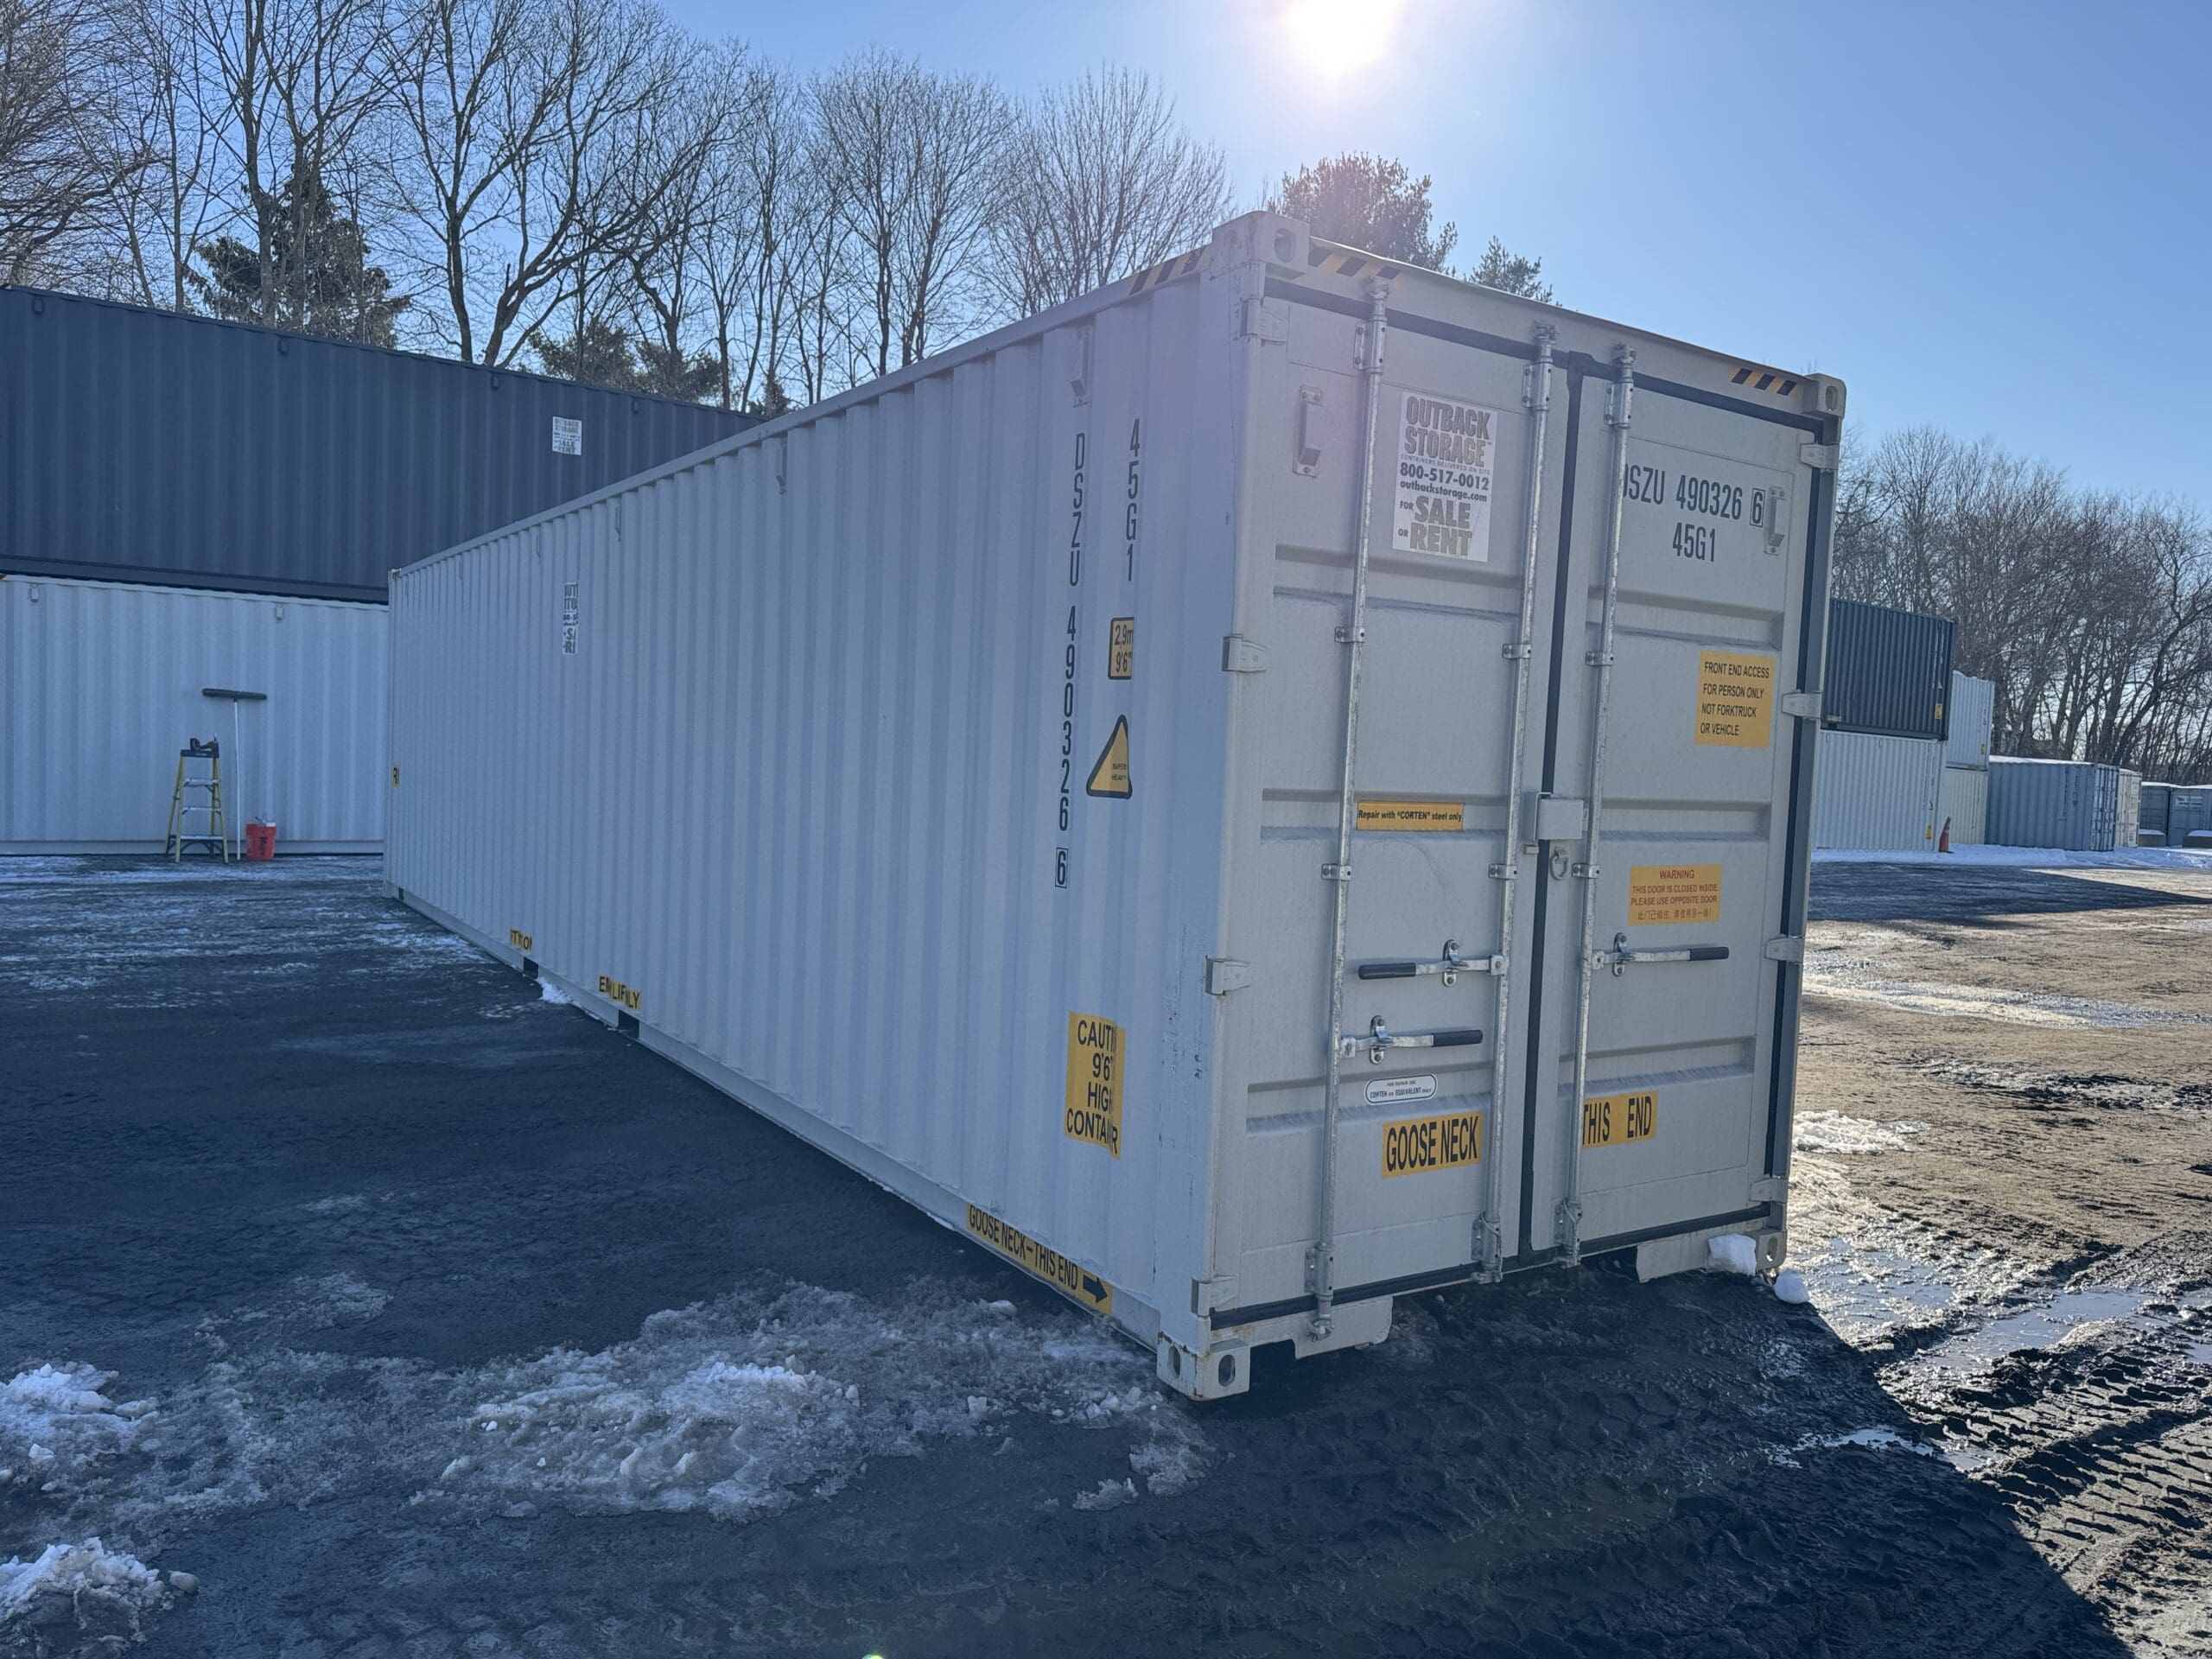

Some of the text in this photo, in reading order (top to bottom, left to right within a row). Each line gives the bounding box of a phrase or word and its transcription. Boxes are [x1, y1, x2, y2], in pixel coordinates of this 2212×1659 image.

[1406, 396, 1491, 440] OUTBACK
[1404, 426, 1485, 467] STORAGE
[1400, 462, 1489, 491] 800-517-0012
[1401, 454, 1435, 466] CONTAINERS
[1437, 461, 1467, 471] DELIVERED
[1126, 418, 1140, 582] 45G1
[1400, 480, 1487, 503] outbackstorage.com
[1676, 474, 1742, 519] 490326
[1751, 491, 1764, 524] 6
[1400, 495, 1471, 530] FOR SALE
[1398, 522, 1472, 556] OR RENT
[1673, 522, 1715, 562] 45G1
[1057, 433, 1085, 886] DSZU 490326 6
[1704, 661, 1770, 678] FRONT END ACCESS
[1703, 683, 1764, 699] FOR PERSON ONLY
[1701, 703, 1757, 718] NOT FORKTRUCK
[1700, 722, 1739, 736] OR VEHICLE
[1358, 810, 1380, 821] Repair
[1449, 813, 1462, 822] only
[1632, 886, 1647, 894] THIS
[1648, 885, 1666, 893] DOOR
[1674, 884, 1698, 893] CLOSED
[1659, 869, 1695, 880] WARNING
[1630, 898, 1655, 906] PLEASE
[1670, 896, 1700, 905] OPPOSITE
[1077, 1020, 1117, 1054] CAUTI
[1395, 1087, 1421, 1096] EQUIVALENT
[1386, 1096, 1652, 1173] GOOSE NECK THIS END
[969, 1204, 1000, 1244] GOOSE
[1058, 1255, 1078, 1291] END
